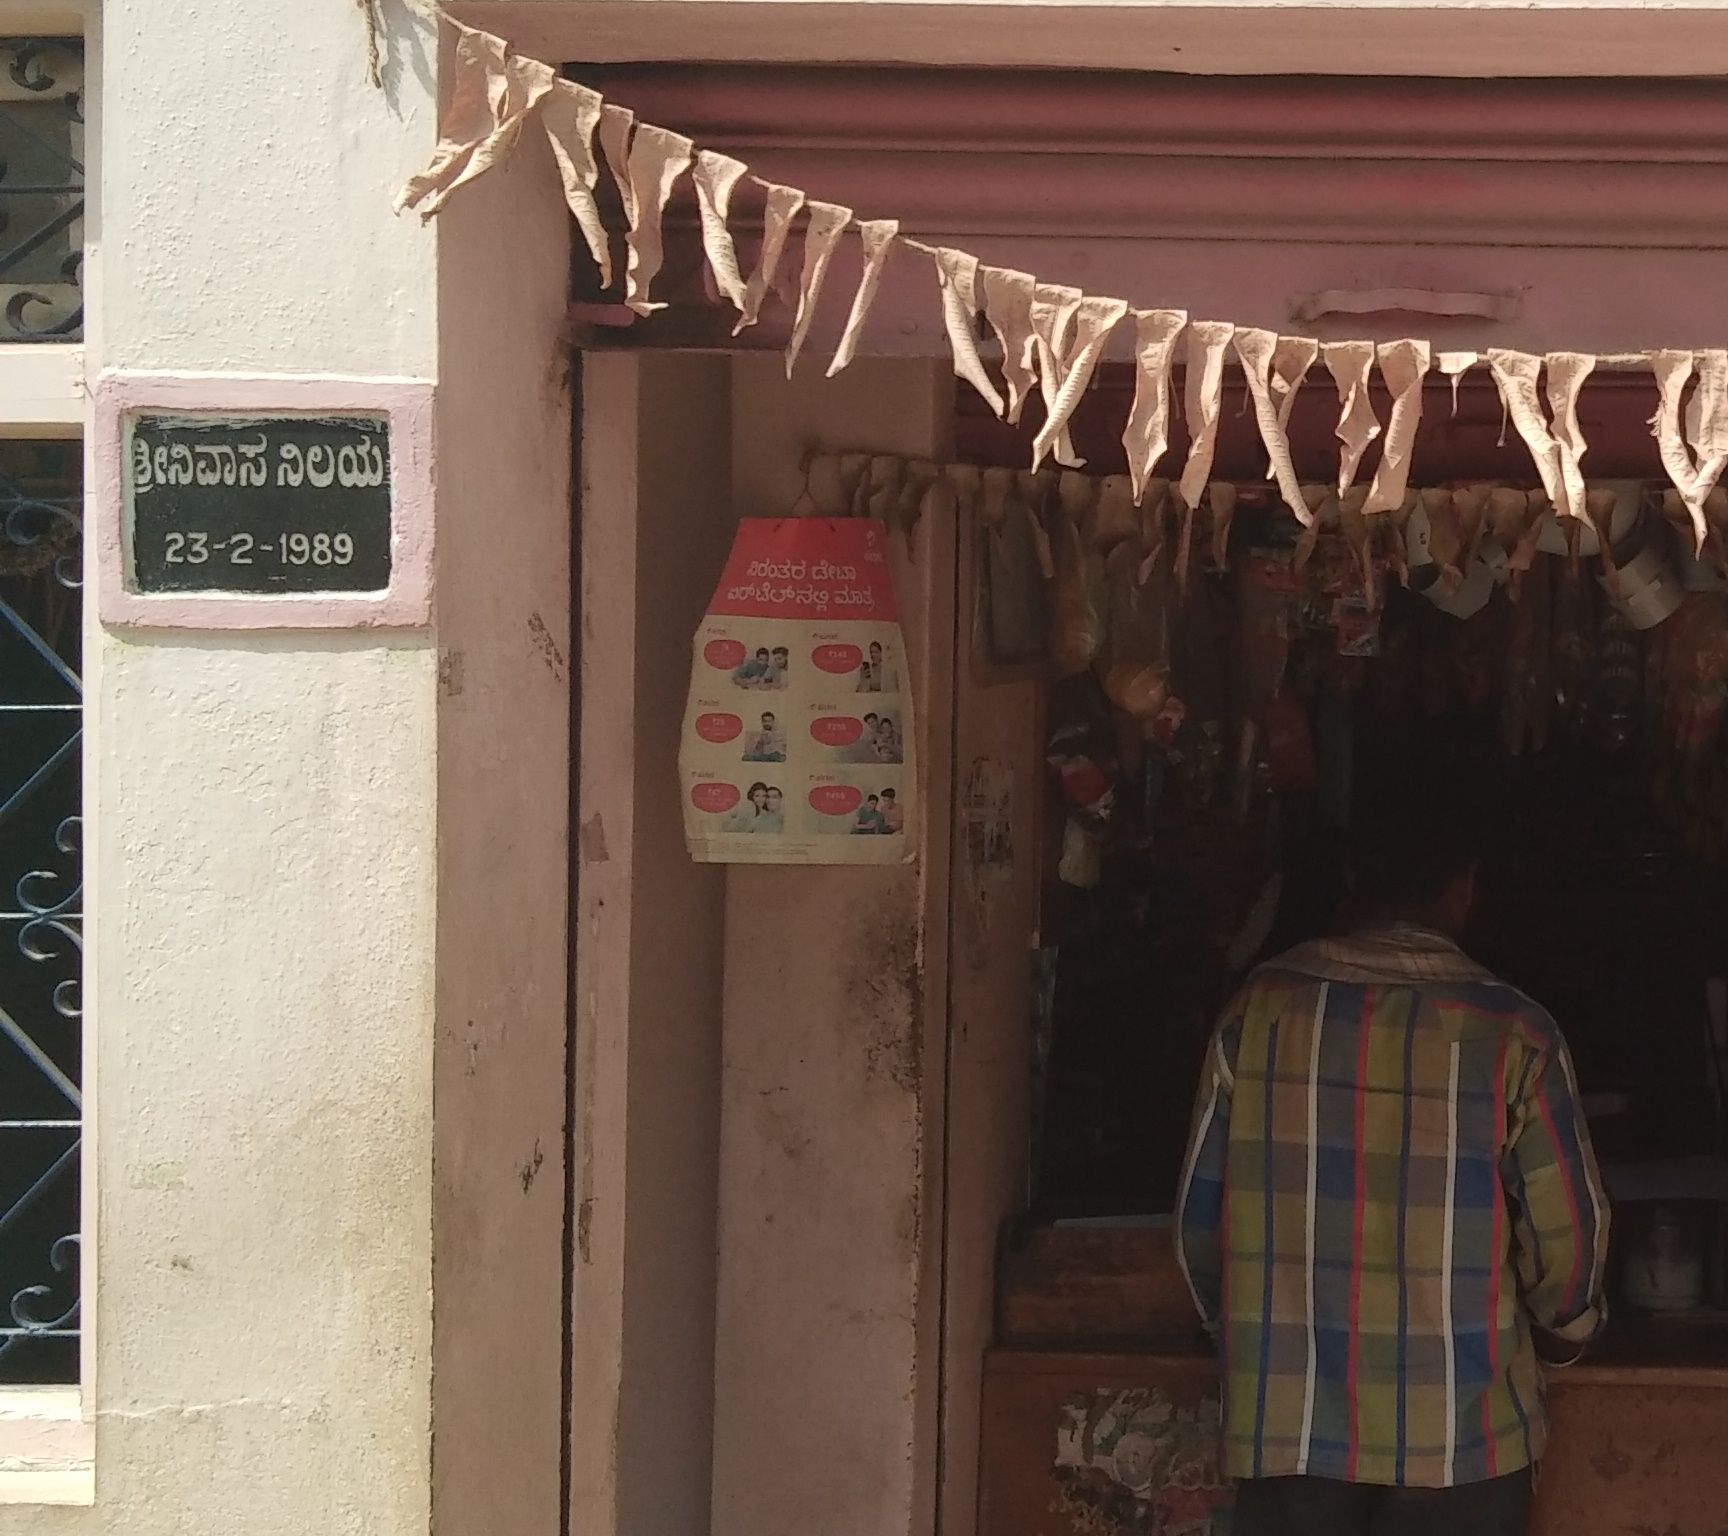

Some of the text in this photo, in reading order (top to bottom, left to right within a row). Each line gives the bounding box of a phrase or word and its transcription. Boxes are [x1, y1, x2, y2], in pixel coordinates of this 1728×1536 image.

[134, 433, 384, 494] ಶ್ರೀನಿವಾಸ ನಿಲಯ
[165, 531, 354, 565] 23-2-1989
